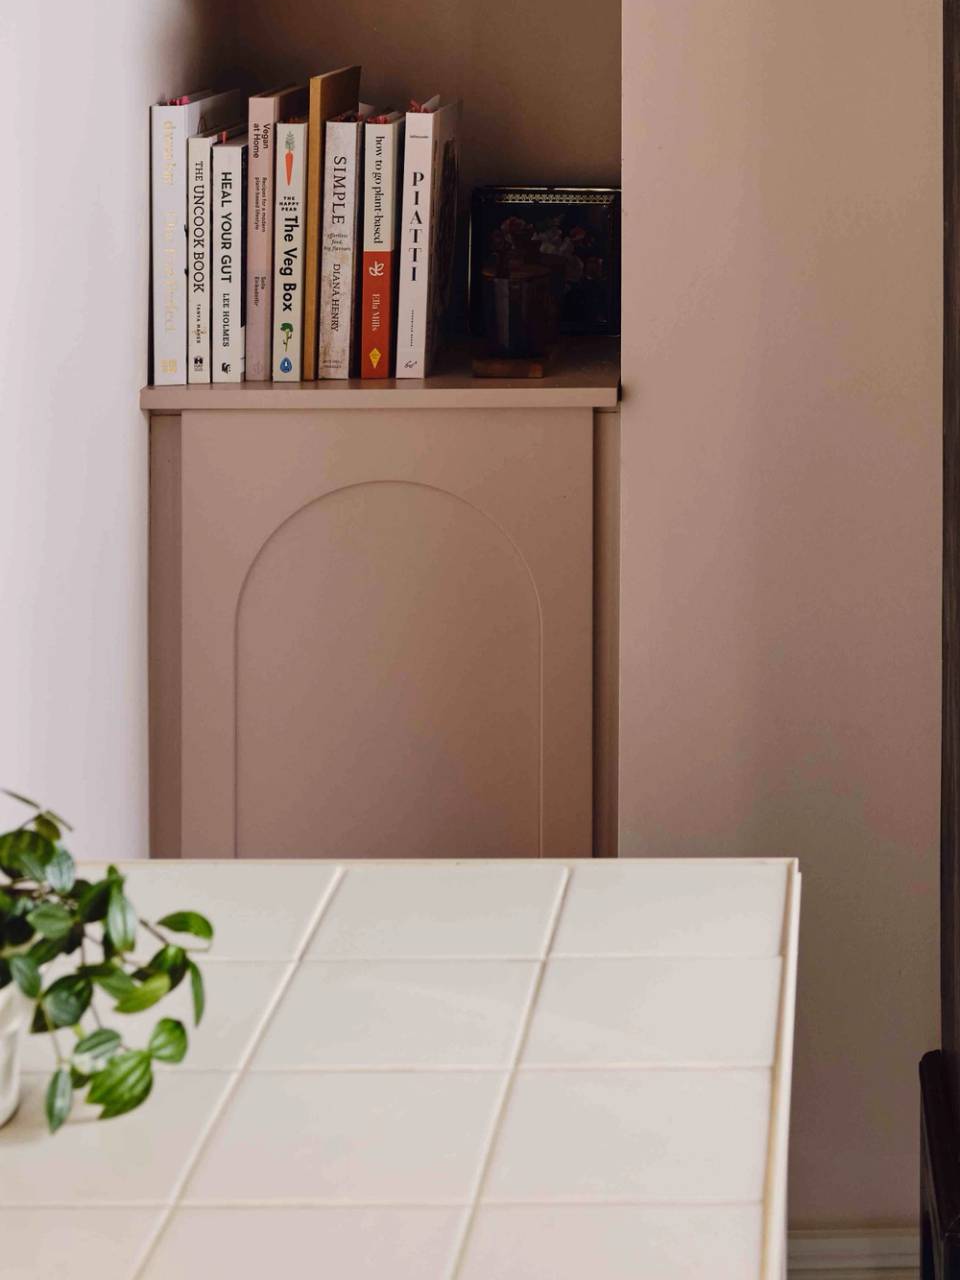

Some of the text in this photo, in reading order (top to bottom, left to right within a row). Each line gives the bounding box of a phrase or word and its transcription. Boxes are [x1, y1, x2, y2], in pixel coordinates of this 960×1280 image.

[252, 123, 261, 159] at Home
[261, 123, 270, 149] Vegan
[195, 161, 204, 181] THE
[332, 155, 347, 225] SIMPLE
[371, 136, 385, 244] how to go plant-based
[193, 185, 205, 248] UNCOOK
[409, 172, 424, 281] PIATTI
[193, 252, 205, 293] BOOK
[220, 171, 232, 347] HEAL YOUR GUT LEE HOLMES
[281, 215, 298, 312] The Veg Box
[330, 263, 341, 332] DIANA HENRY
[371, 293, 381, 331] Ella Mills
